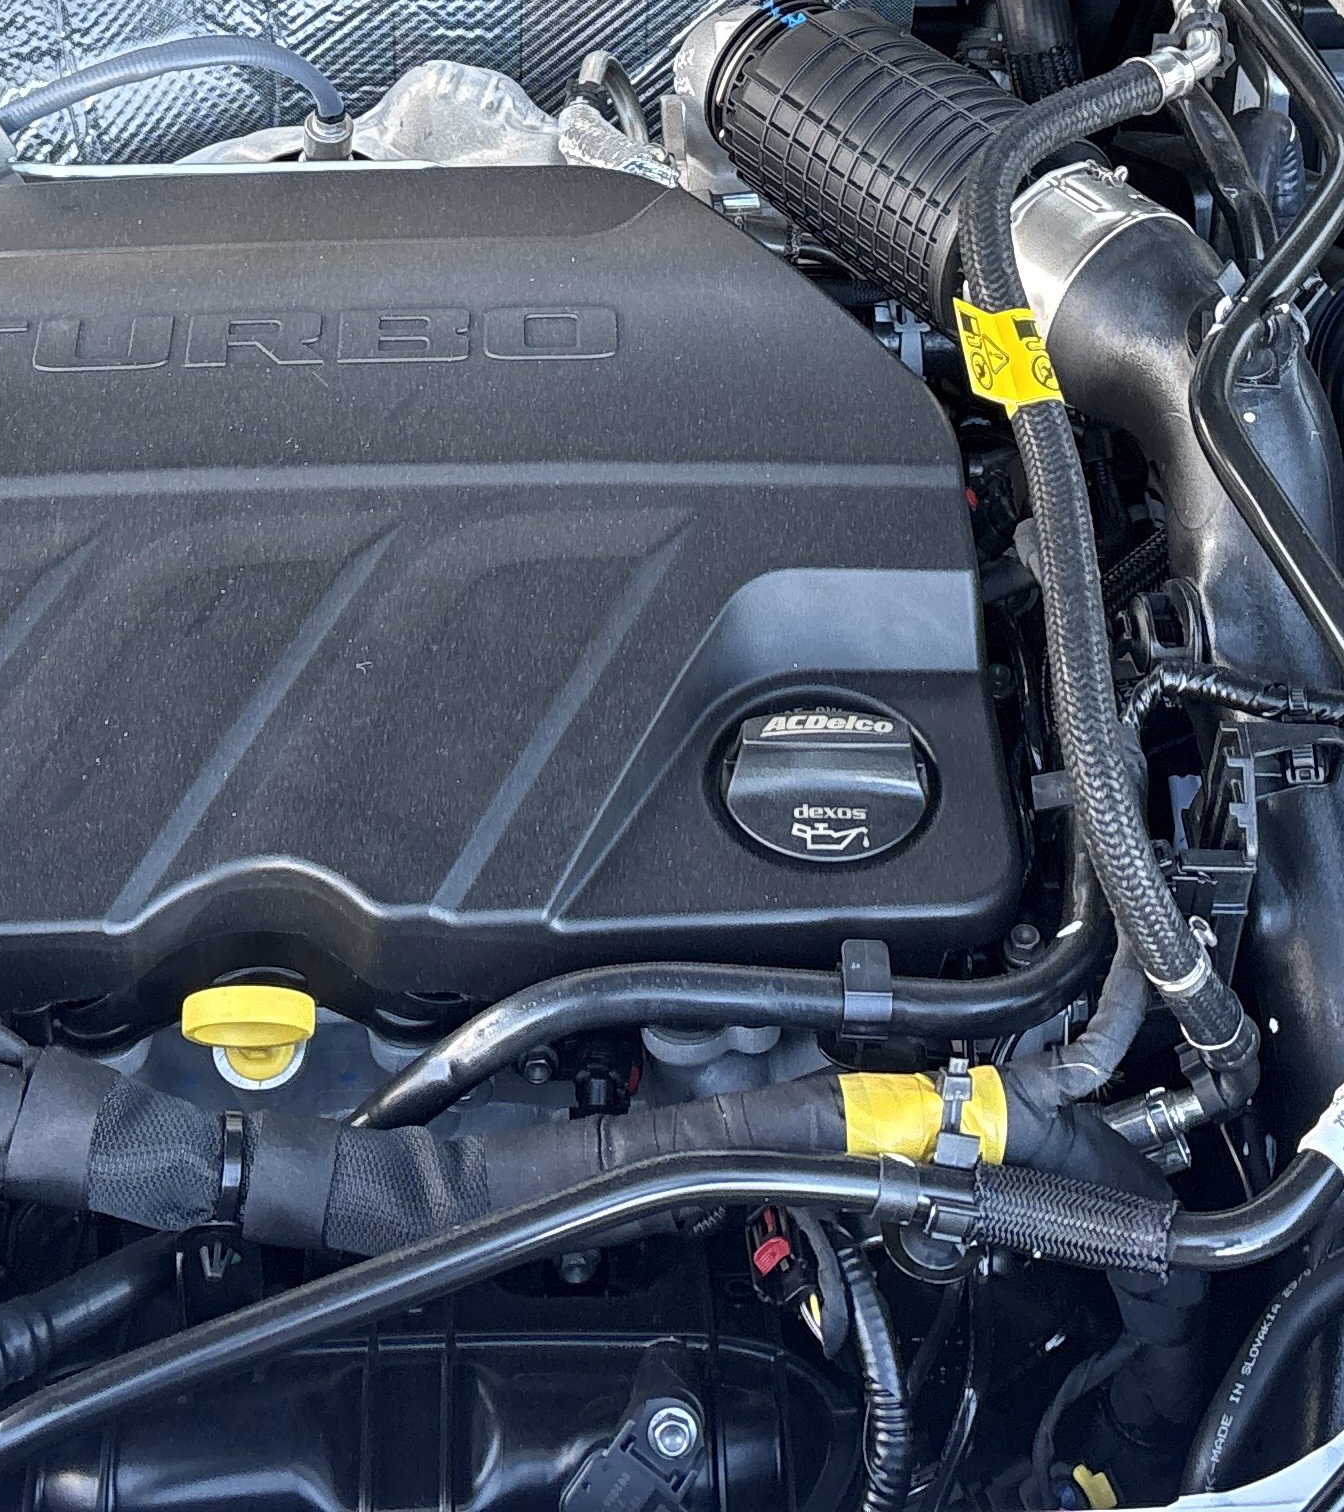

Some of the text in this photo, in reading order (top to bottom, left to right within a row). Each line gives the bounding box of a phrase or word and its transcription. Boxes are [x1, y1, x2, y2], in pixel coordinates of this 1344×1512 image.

[762, 715, 894, 734] ACDelco
[793, 803, 869, 821] dexos
[1241, 1303, 1282, 1376] SLOVAKIA
